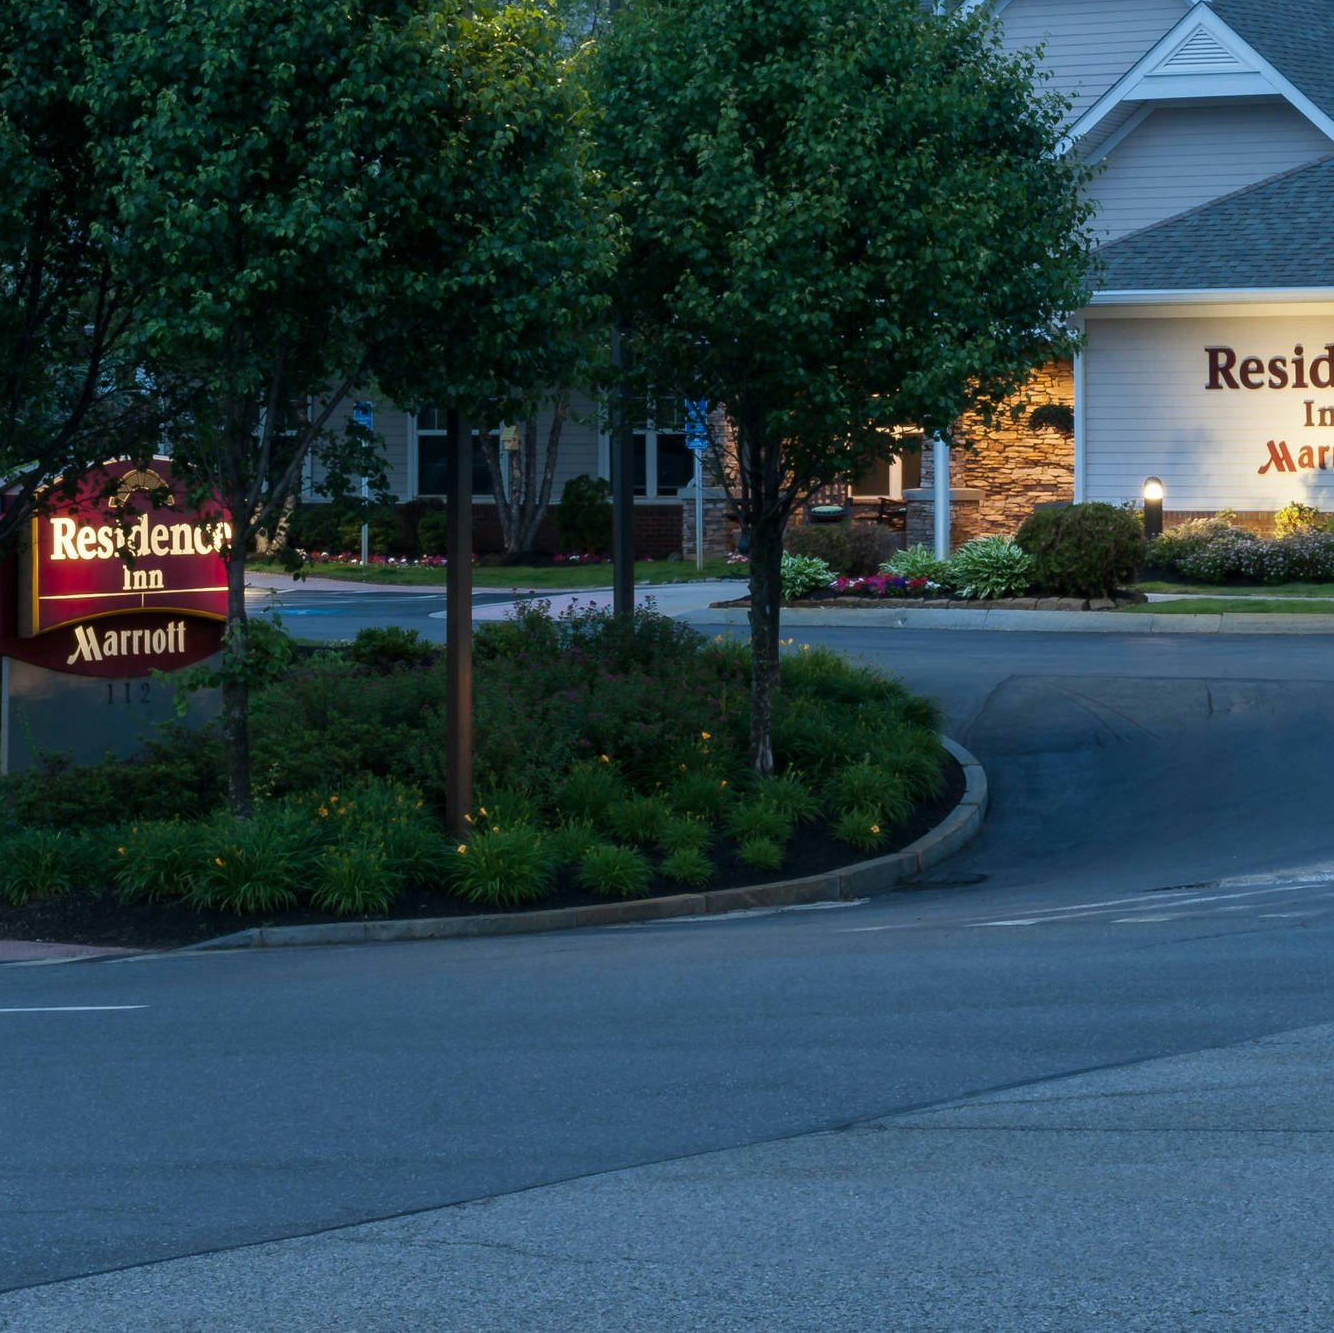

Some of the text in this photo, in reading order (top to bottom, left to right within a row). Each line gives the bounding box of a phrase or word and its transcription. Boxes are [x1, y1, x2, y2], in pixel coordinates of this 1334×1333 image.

[123, 565, 164, 590] Inn
[67, 620, 186, 665] Marriott
[107, 682, 151, 704] 112
